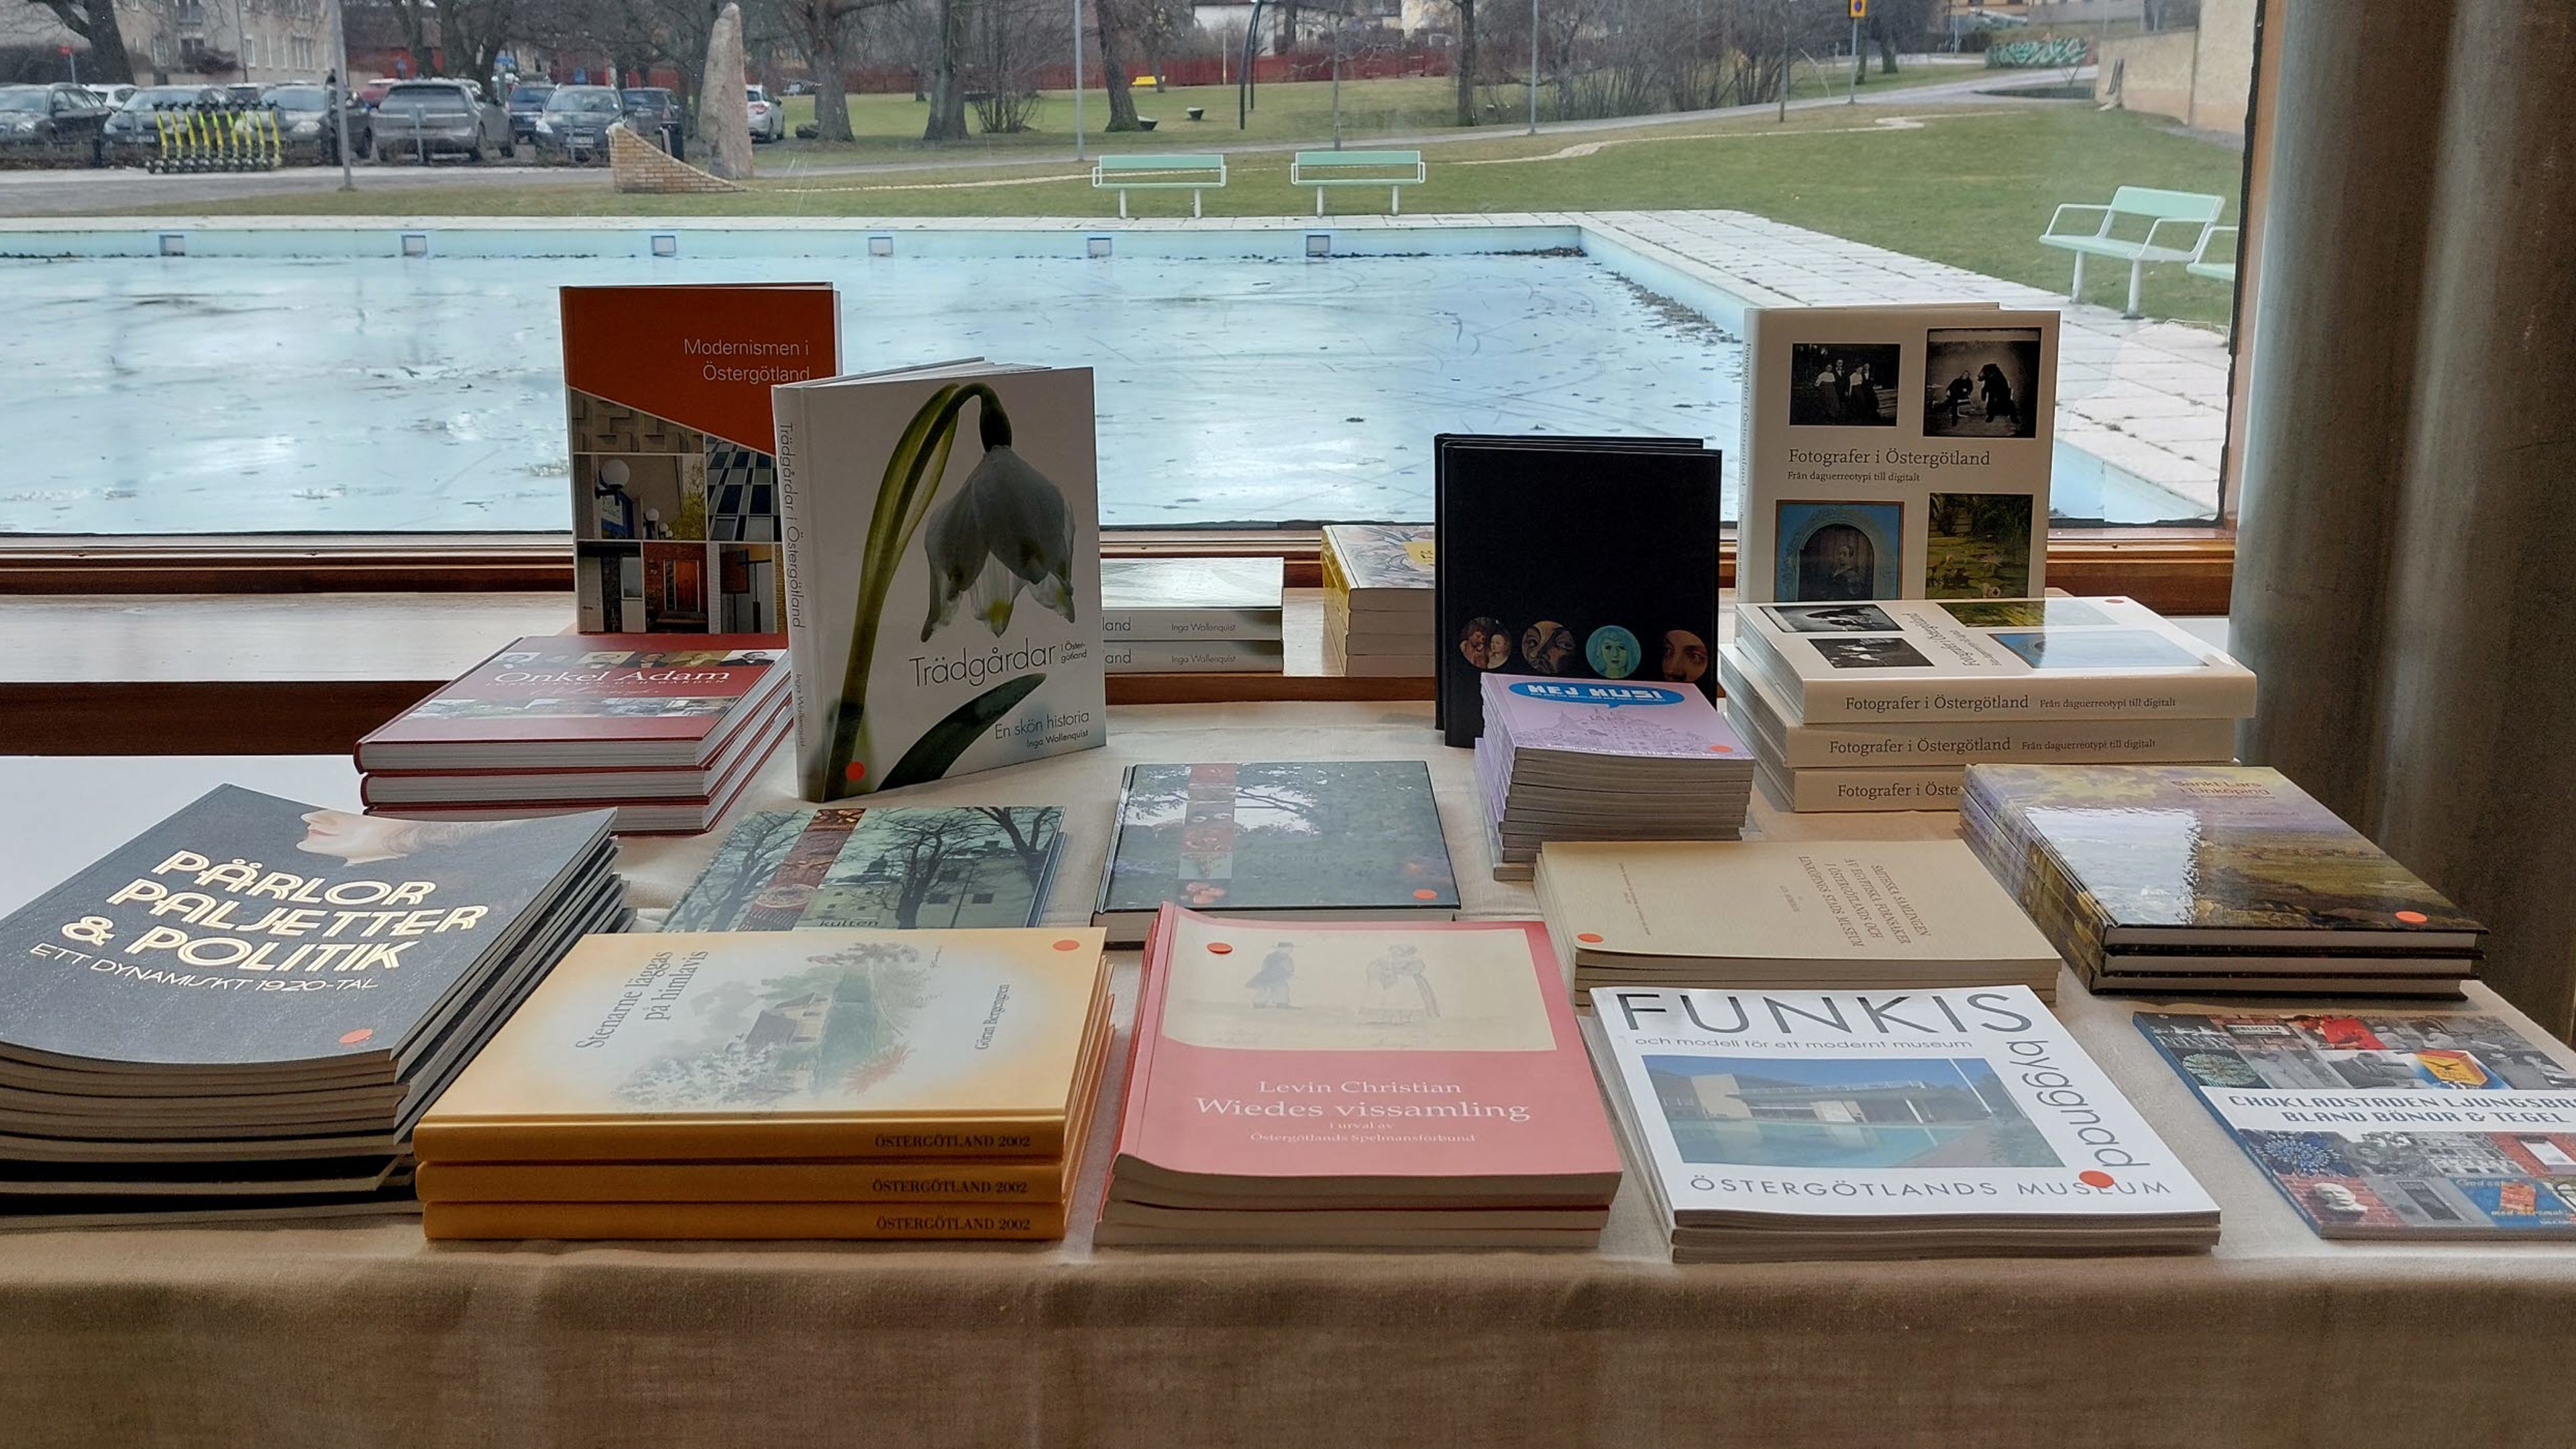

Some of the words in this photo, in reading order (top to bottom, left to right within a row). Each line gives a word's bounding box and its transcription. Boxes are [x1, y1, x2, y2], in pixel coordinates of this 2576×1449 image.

[684, 338, 800, 358] Modernismen
[804, 339, 810, 356] i
[702, 362, 810, 384] Östergötland
[1788, 449, 1870, 466] Fotografer
[1875, 450, 1880, 463] i
[1886, 447, 1990, 469] Östergötland
[1787, 471, 1807, 480] Från
[1809, 471, 1872, 482] daguerreotypi
[1874, 471, 1886, 481] till
[1888, 472, 1921, 482] digitalt
[778, 422, 795, 511] Trädgårdar
[788, 525, 806, 629] Östergötland
[1171, 623, 1188, 633] Inga
[1191, 622, 1236, 633] Wallenquist
[909, 637, 1056, 687] Trädgårdar
[1172, 655, 1188, 664] Inga
[1191, 654, 1236, 664] Wallenquist
[493, 670, 611, 682] Onkel
[614, 670, 730, 682] Adam
[1845, 696, 1921, 713] Fotografer
[1925, 696, 1930, 709] i
[1935, 694, 2029, 712] Östergötland
[2040, 698, 2059, 708] Från
[2062, 698, 2127, 710] daguerreotypi
[2129, 698, 2140, 708] till
[2143, 697, 2176, 708] digitalt
[995, 723, 1011, 739] En
[1014, 717, 1044, 736] skön
[1046, 709, 1089, 732] historia
[1026, 737, 1044, 749] Inga
[1045, 729, 1088, 745] Wallenquist
[1829, 740, 1903, 757] Fotografer
[1907, 740, 1913, 752] i
[1917, 737, 2010, 756] Östergötland
[2022, 741, 2041, 750] Från
[2044, 740, 2107, 752] daguerreotypi
[2109, 739, 2121, 749] till
[2124, 739, 2155, 750] digitalt
[1838, 784, 1911, 800] Fotografer
[1916, 784, 1921, 796] i
[152, 849, 437, 905] PÄRLOR
[105, 878, 490, 940] PALJETTER
[60, 915, 115, 947] &
[125, 925, 419, 973] POLITIK
[29, 943, 93, 965] ETT
[91, 960, 254, 991] DYNAMISKT
[254, 977, 379, 991] 1920-TAL
[651, 951, 708, 1001] himlavis
[575, 991, 643, 1048] Stenarne
[625, 951, 673, 987] läggas
[983, 984, 1010, 1024] Bergengren
[642, 1005, 672, 1020] på
[1616, 992, 2033, 1036] FUNKIS
[975, 1026, 996, 1049] Göran
[1635, 1036, 1672, 1048] och
[1676, 1035, 1740, 1049] modell
[1744, 1036, 1772, 1049] för
[1774, 1037, 1801, 1049] ett
[1803, 1037, 1888, 1050] modernt
[1891, 1040, 1973, 1051] museum
[1259, 1081, 1331, 1093] Levin
[1341, 1080, 1462, 1094] Christian
[1195, 1097, 1324, 1118] Wiedes
[1336, 1101, 1530, 1121] vissamling
[2006, 1040, 2151, 1169] byggnad
[2229, 1095, 2440, 1108] CHOKLADSTADEN
[2443, 1097, 2576, 1108] LJUNGSBR
[1339, 1121, 1374, 1130] urval
[2282, 1111, 2369, 1122] BLAND
[2371, 1109, 2463, 1122] BÖNOR
[2465, 1112, 2485, 1122] &
[2489, 1112, 2571, 1123] TEGEL
[875, 1134, 994, 1147] ÖSTERGÖTLAND
[999, 1136, 1030, 1147] 2002
[872, 1179, 991, 1193] ÖSTERGÖTLAND
[996, 1181, 1028, 1193] 2002
[1690, 1175, 1998, 1197] ÖSTERGÖTLANDS
[876, 1216, 994, 1230] ÖSTERGÖTLAND
[999, 1219, 1030, 1230] 2002
